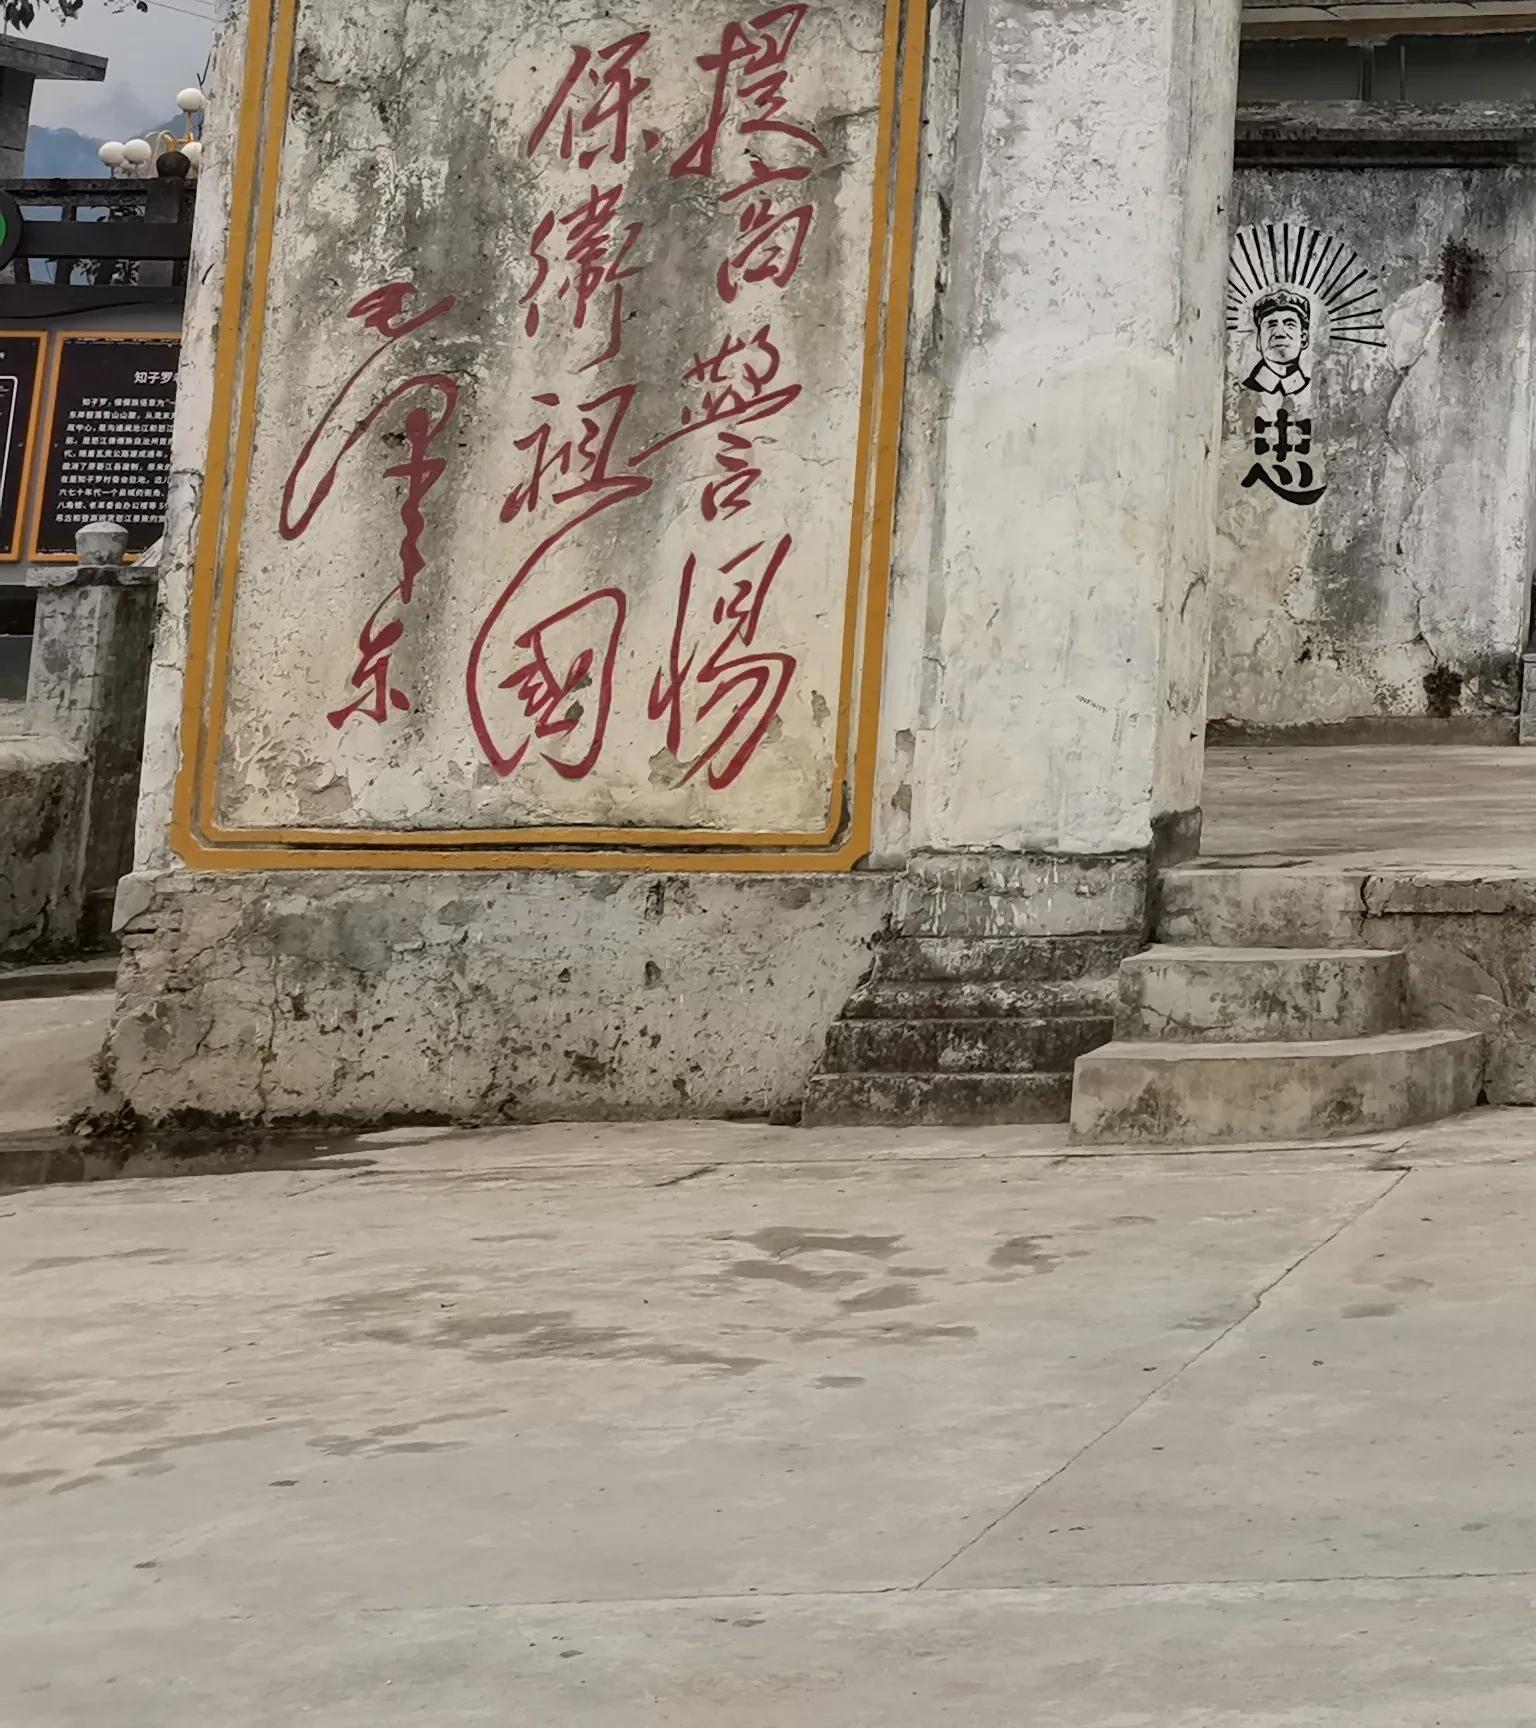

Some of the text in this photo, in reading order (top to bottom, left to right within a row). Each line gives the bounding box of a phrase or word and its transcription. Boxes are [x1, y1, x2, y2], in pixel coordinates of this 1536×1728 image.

[646, 2, 829, 790] 提高警惕
[1240, 407, 1327, 506] 忠
